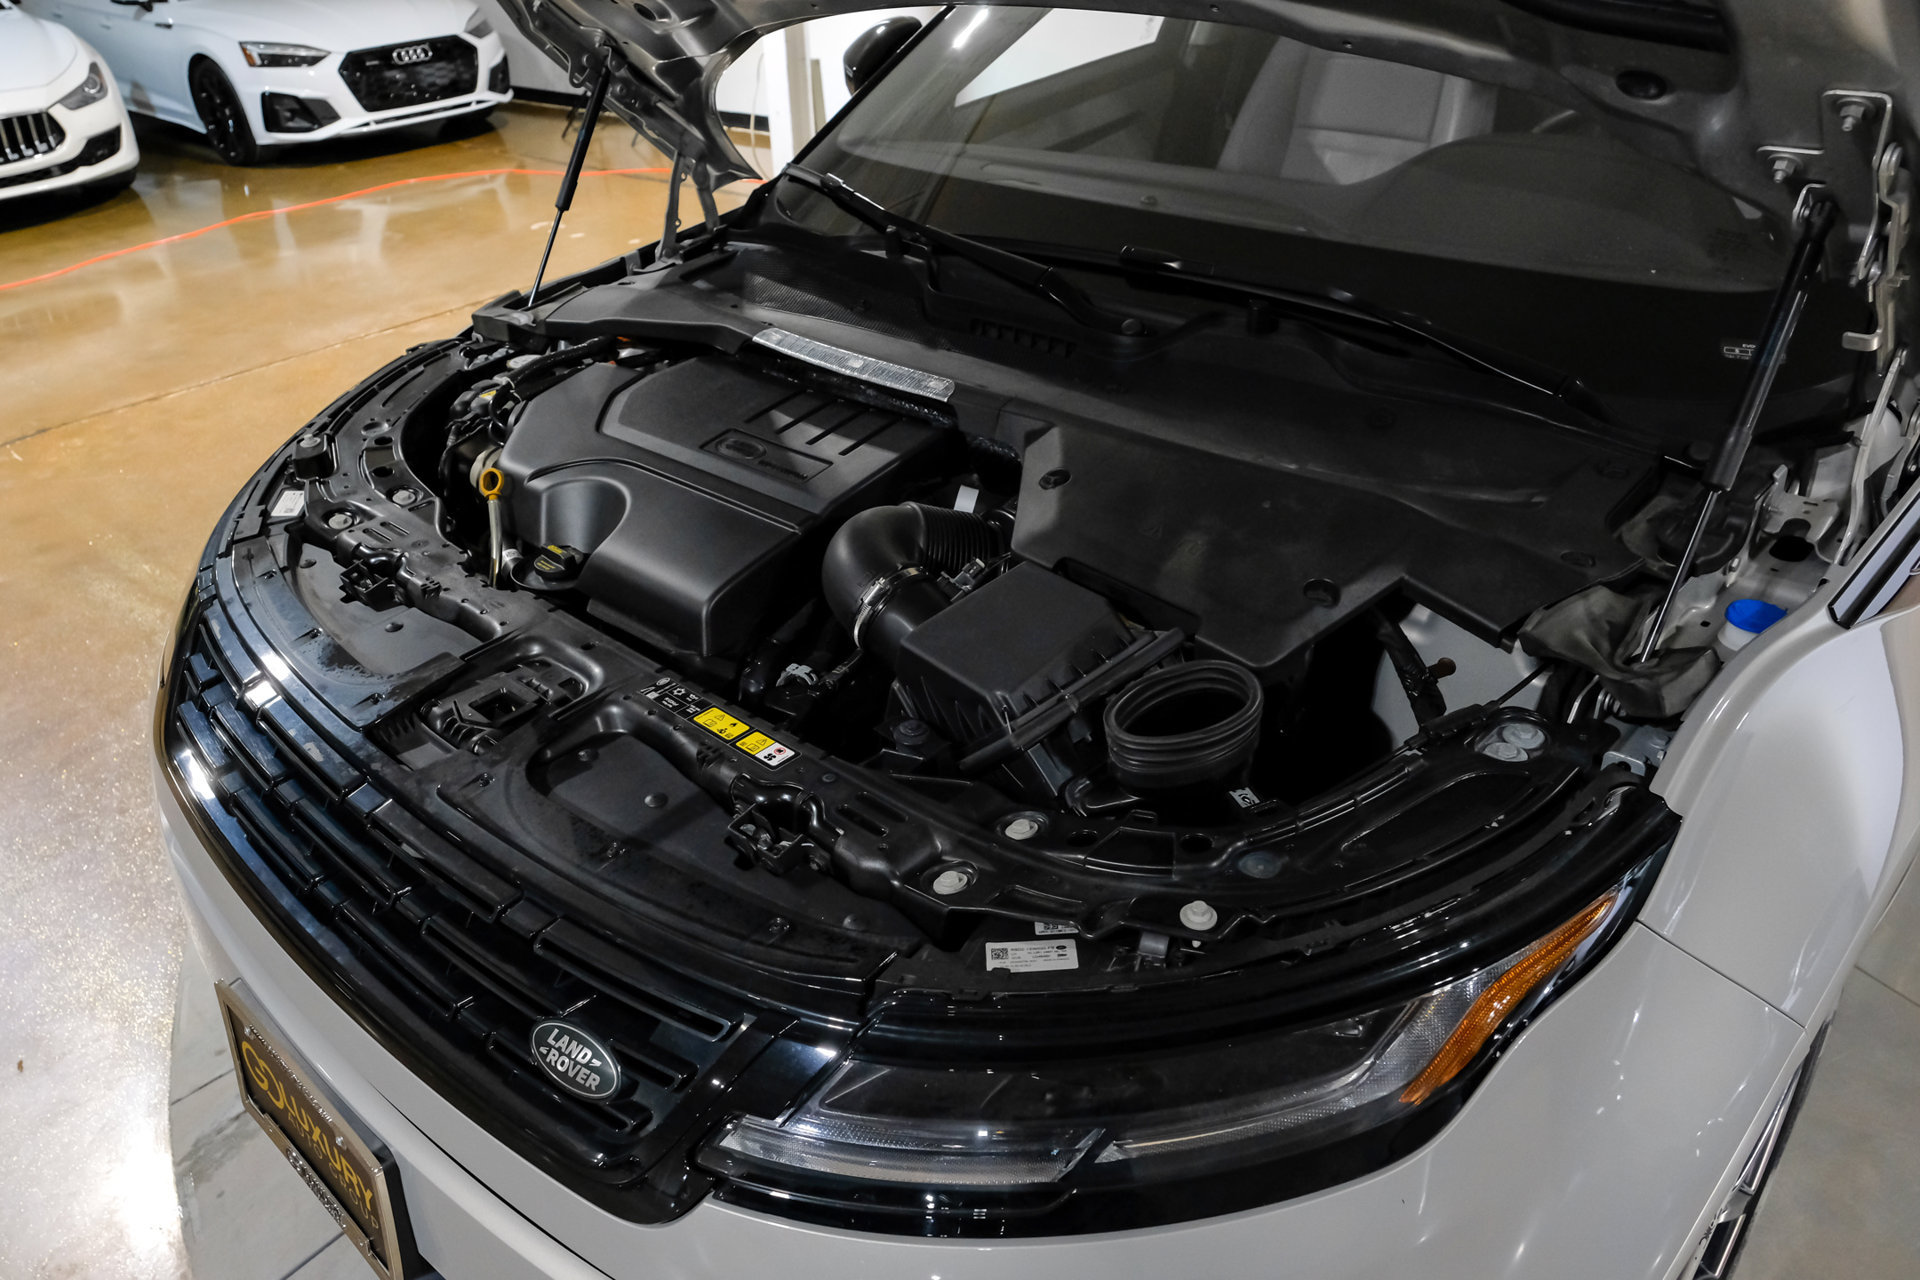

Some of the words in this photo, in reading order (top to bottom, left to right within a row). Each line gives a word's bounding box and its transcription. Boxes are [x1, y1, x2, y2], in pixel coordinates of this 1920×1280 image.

[546, 1048, 600, 1091] ROVER
[547, 1028, 592, 1065] LAND
[279, 1081, 373, 1210] LUXURY
[329, 1162, 378, 1229] GROUP
